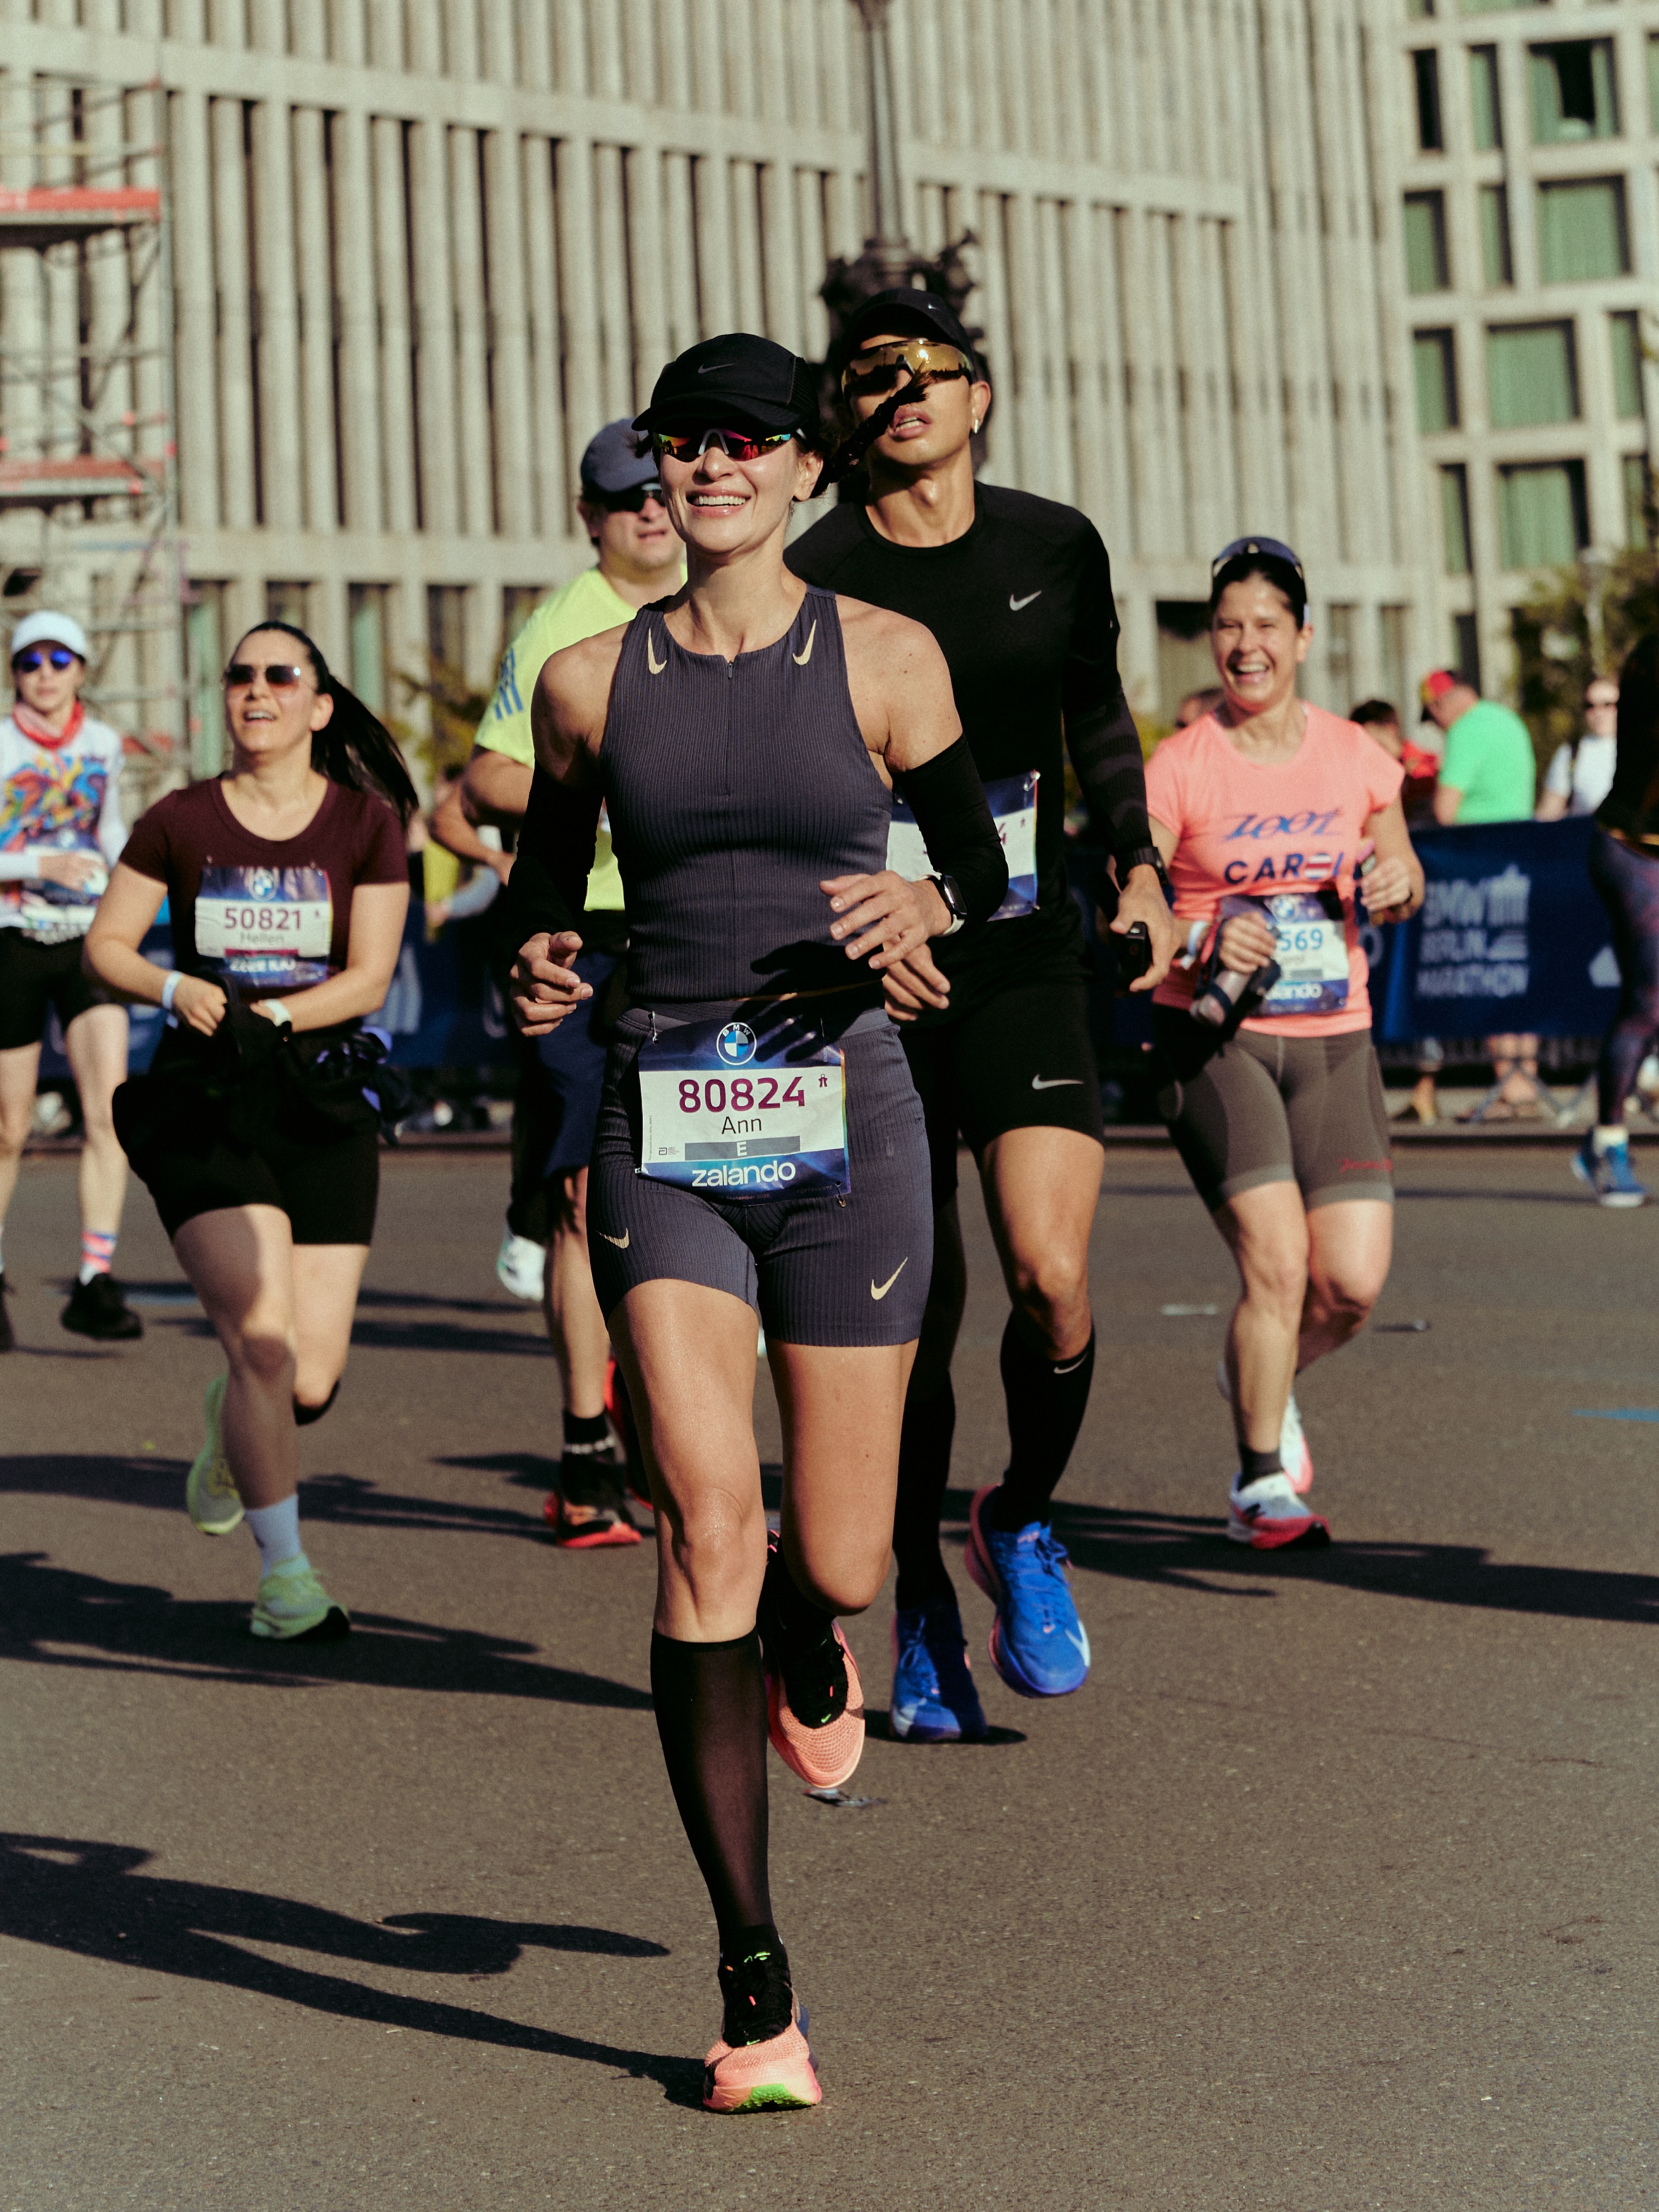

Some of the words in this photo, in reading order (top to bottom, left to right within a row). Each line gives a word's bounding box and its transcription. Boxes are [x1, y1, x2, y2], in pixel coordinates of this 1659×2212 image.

[224, 907, 301, 930] 50821
[1278, 928, 1323, 952] 569
[722, 1024, 751, 1037] BMW
[678, 1076, 805, 1113] 80824
[721, 1116, 762, 1135] Ann
[737, 1141, 747, 1157] E
[692, 1160, 796, 1187] zalando
